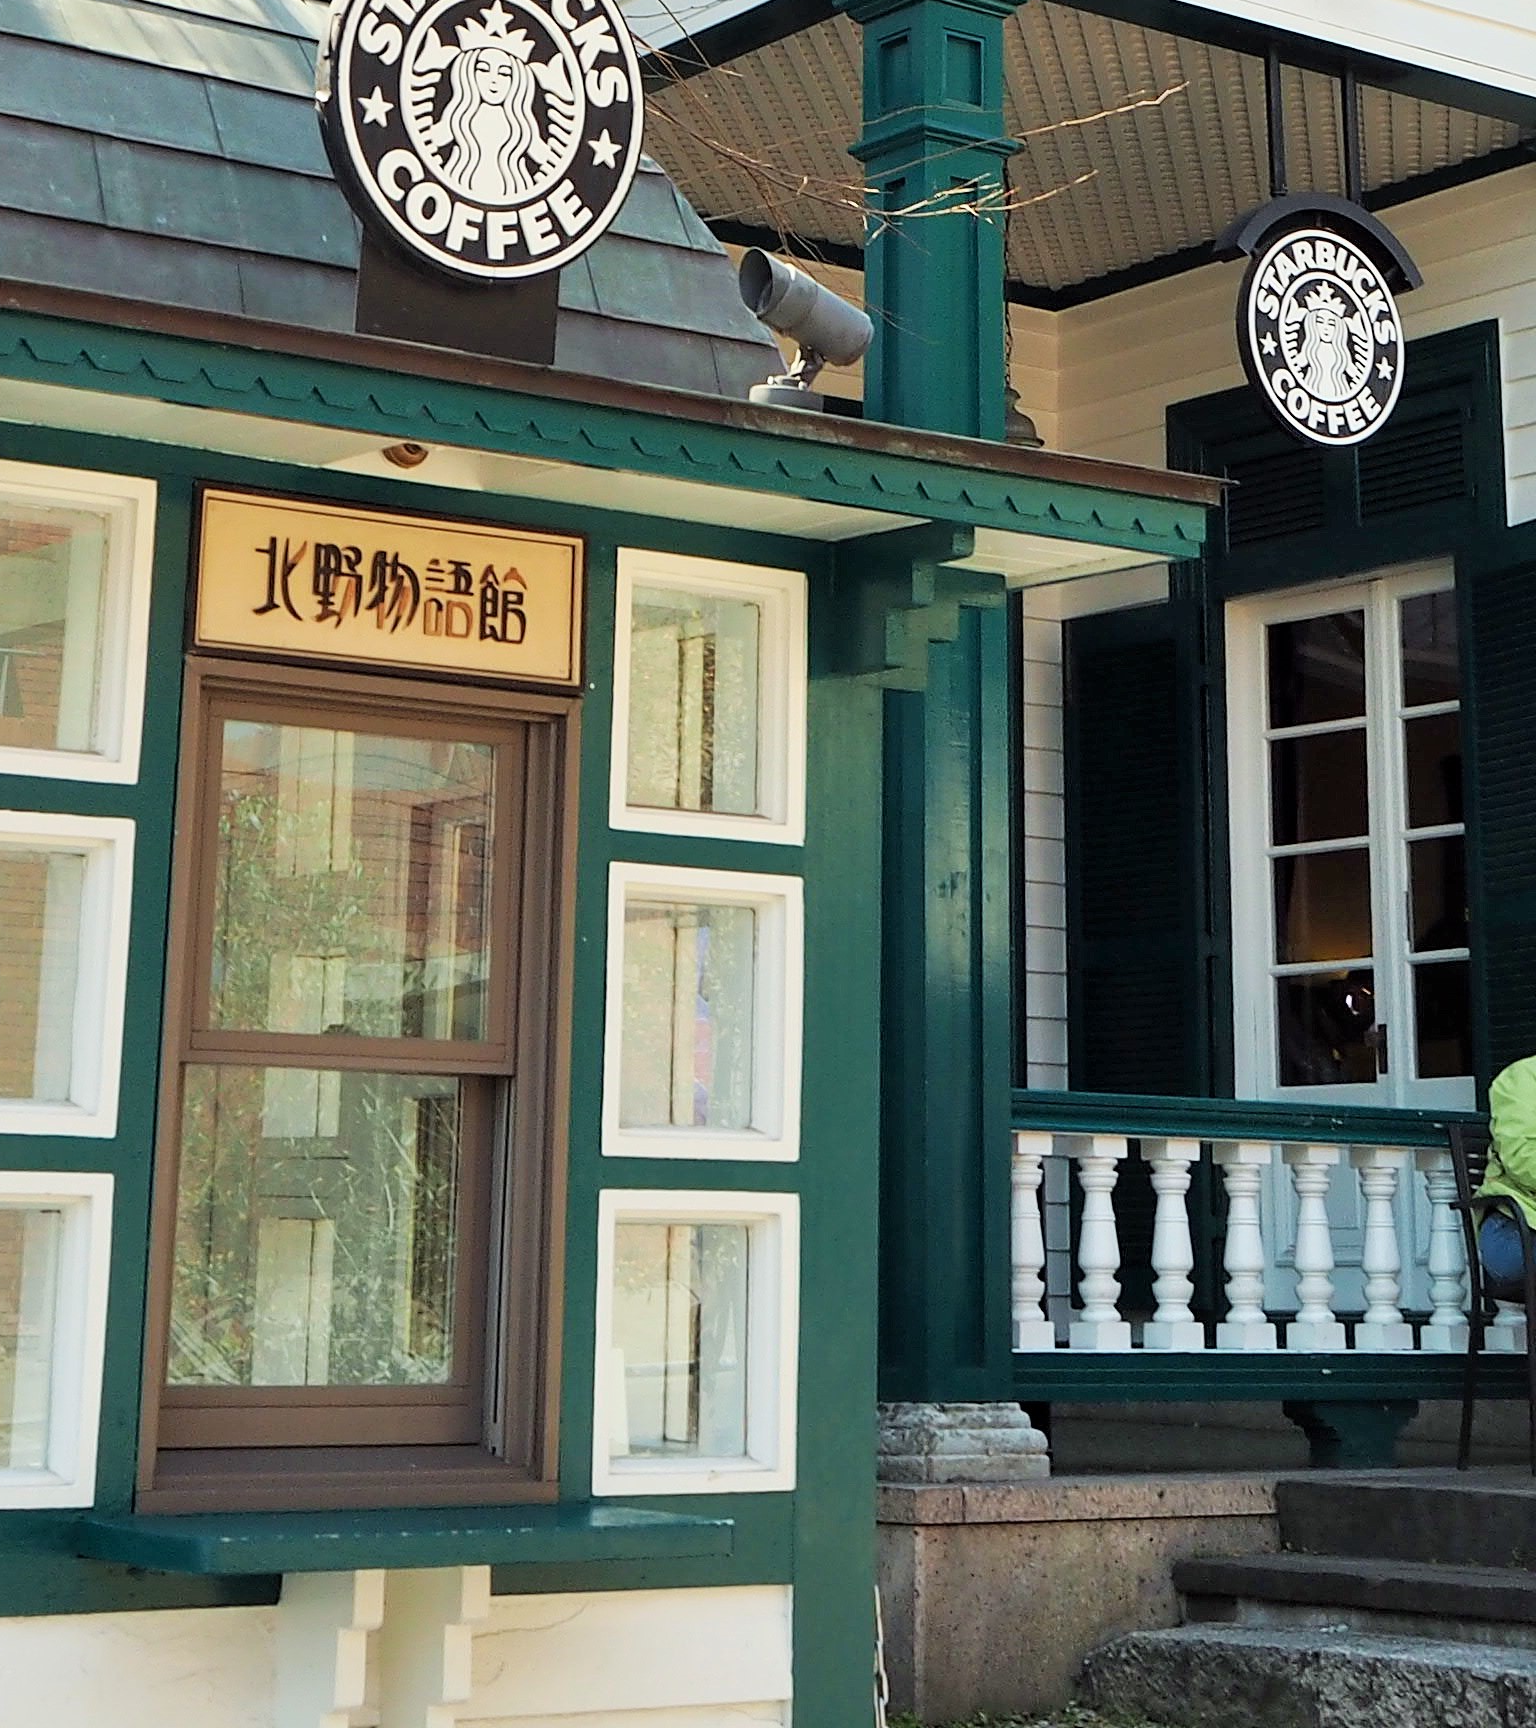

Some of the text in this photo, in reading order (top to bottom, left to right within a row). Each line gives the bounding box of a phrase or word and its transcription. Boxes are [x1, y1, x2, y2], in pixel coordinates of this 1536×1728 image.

[378, 148, 593, 261] COFFEE
[1256, 240, 1396, 345] STARBUCKS
[1271, 368, 1382, 435] COFFEE
[252, 535, 528, 645] 北野物語館
